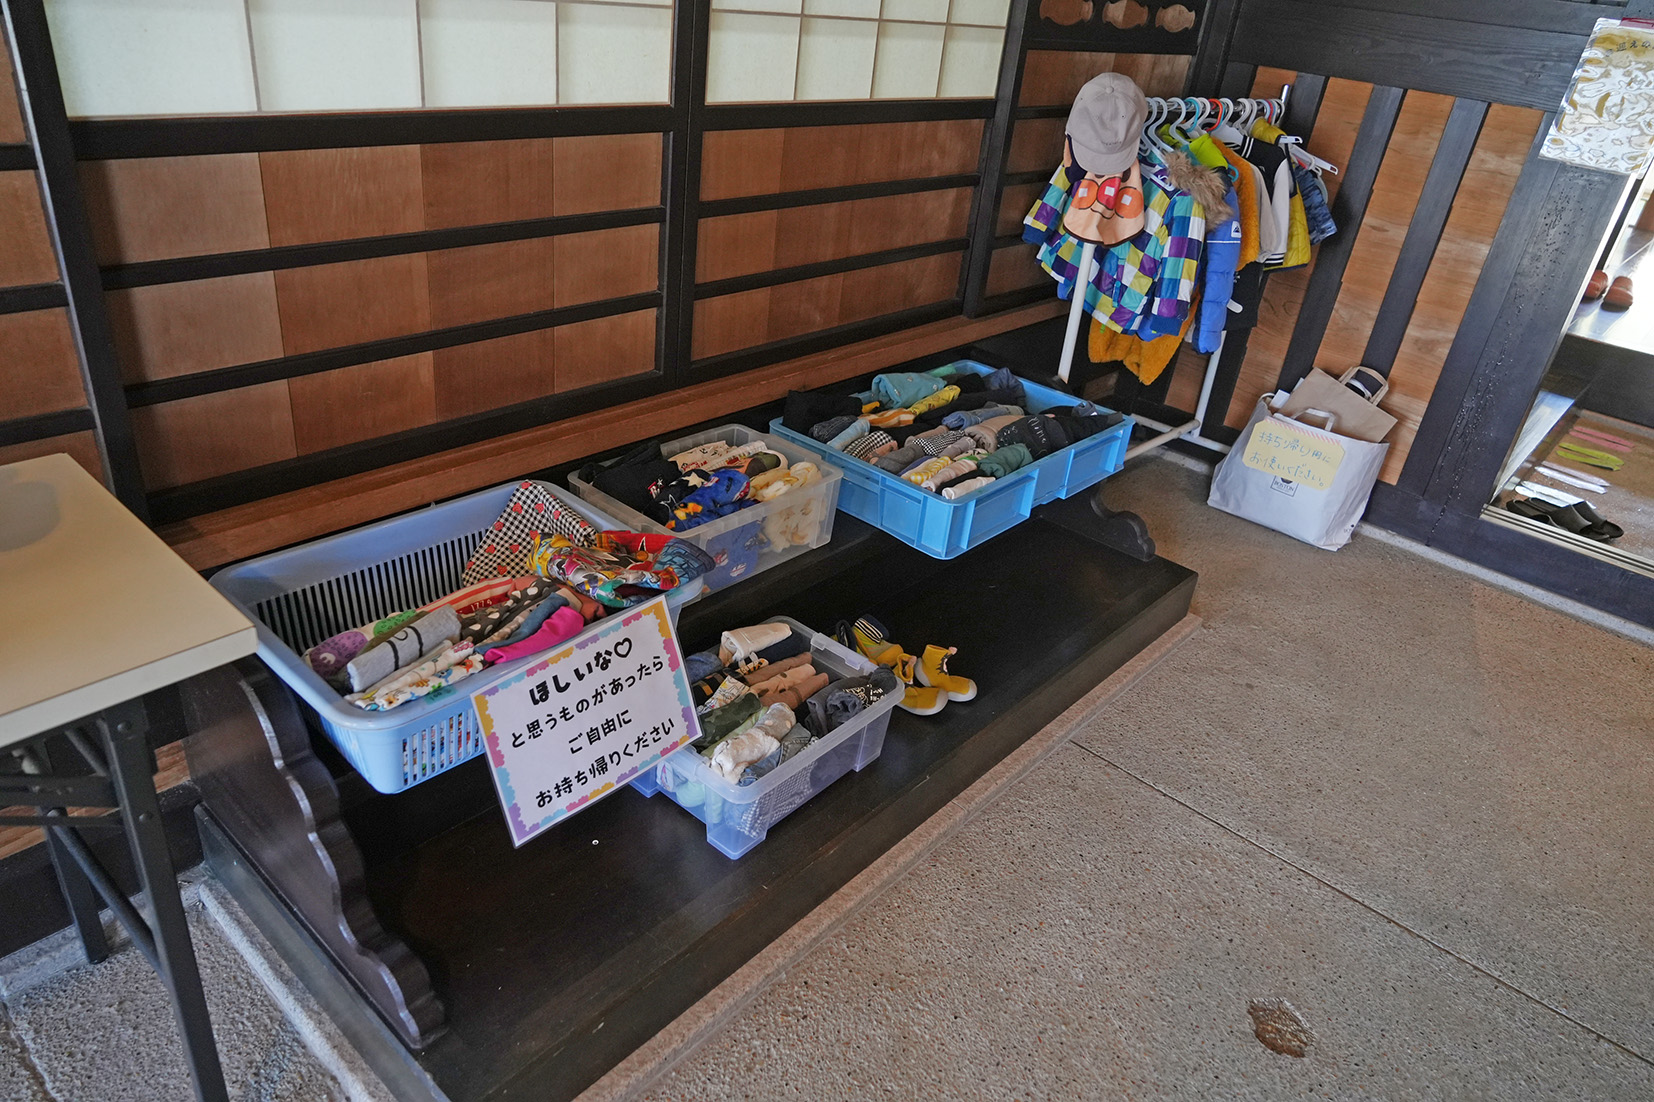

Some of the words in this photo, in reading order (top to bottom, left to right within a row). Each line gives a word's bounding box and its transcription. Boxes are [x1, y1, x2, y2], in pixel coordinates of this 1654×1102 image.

[1259, 432, 1331, 463] 持ち帰り用に
[511, 655, 664, 749] と思うものがあったら
[568, 709, 632, 754] ご自由に
[535, 718, 675, 808] お持ち帰りください
